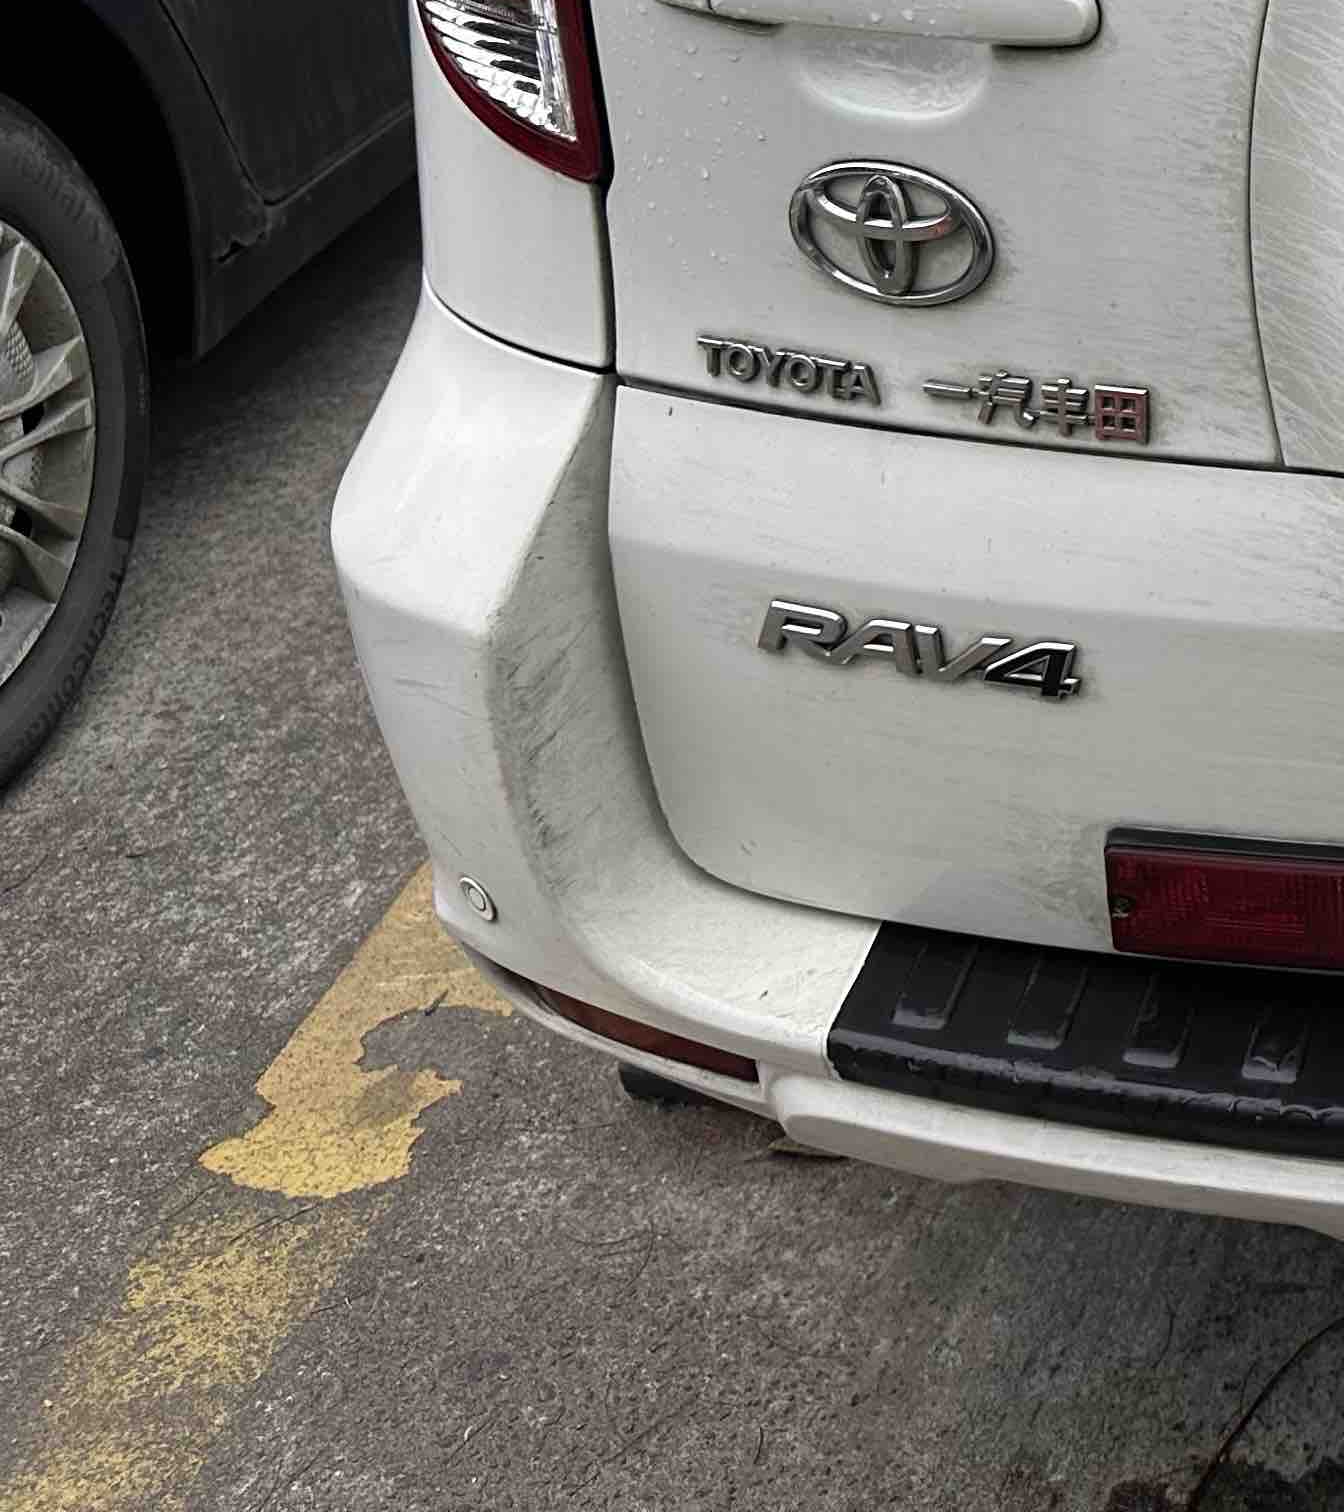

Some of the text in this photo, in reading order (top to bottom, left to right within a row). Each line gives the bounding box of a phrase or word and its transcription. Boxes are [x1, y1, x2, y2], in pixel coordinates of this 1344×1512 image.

[697, 334, 1151, 445] TOYOTA 一汽丰田
[757, 597, 1083, 701] RAV4
